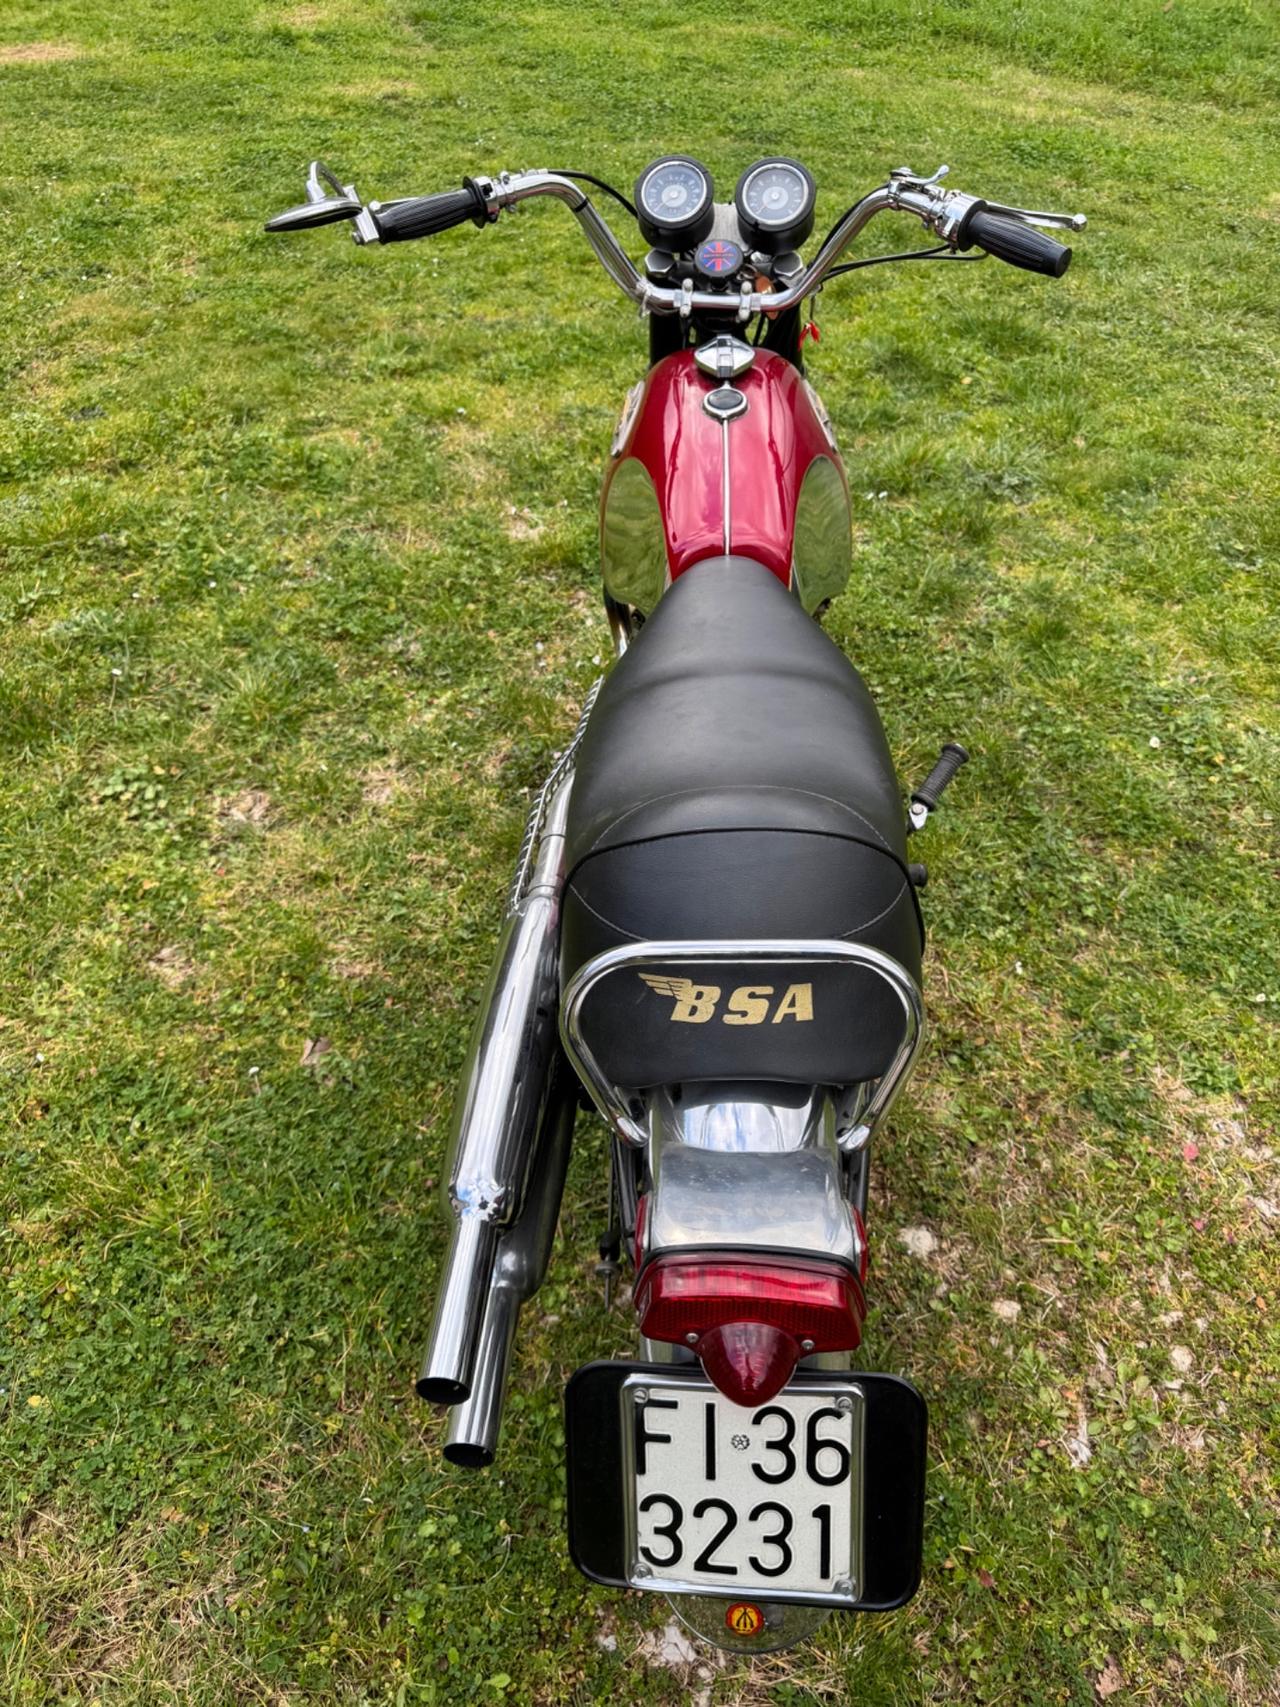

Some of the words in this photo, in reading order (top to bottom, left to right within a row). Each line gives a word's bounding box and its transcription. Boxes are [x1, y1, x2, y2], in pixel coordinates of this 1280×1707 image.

[670, 983, 814, 1026] BSA
[635, 1397, 716, 1481] FI
[751, 1405, 852, 1487] 36
[639, 1493, 832, 1580] 3231
